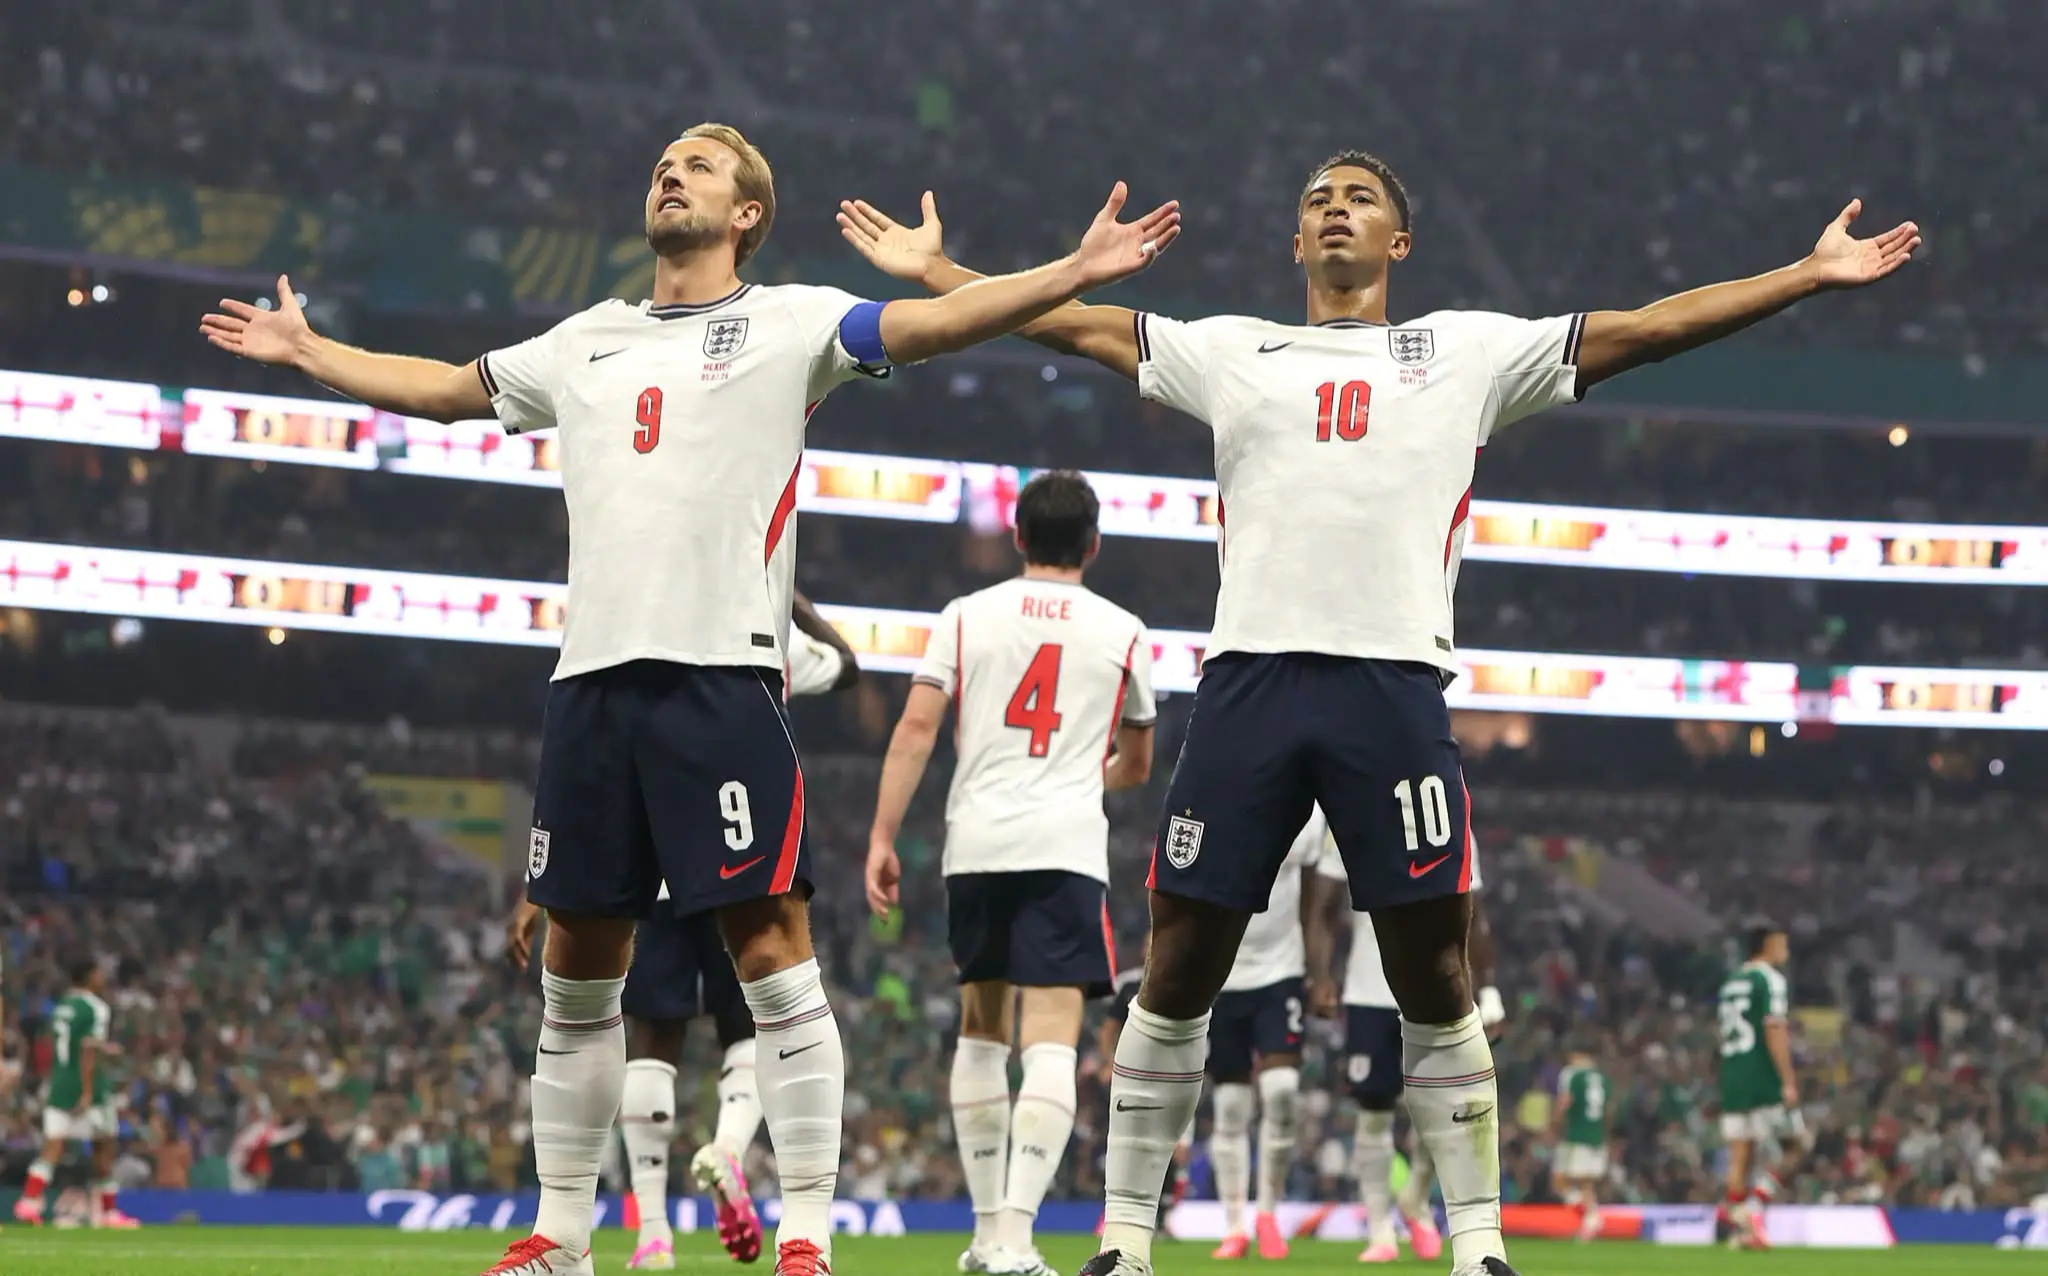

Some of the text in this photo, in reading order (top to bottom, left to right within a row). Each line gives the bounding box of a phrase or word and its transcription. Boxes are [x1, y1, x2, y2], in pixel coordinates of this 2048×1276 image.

[633, 386, 663, 454] 9
[1316, 381, 1371, 442] 10
[1021, 596, 1072, 620] RICE
[1004, 643, 1062, 757] 4
[718, 780, 754, 852] 9
[1393, 775, 1452, 851] 10
[1285, 996, 1304, 1033] 2
